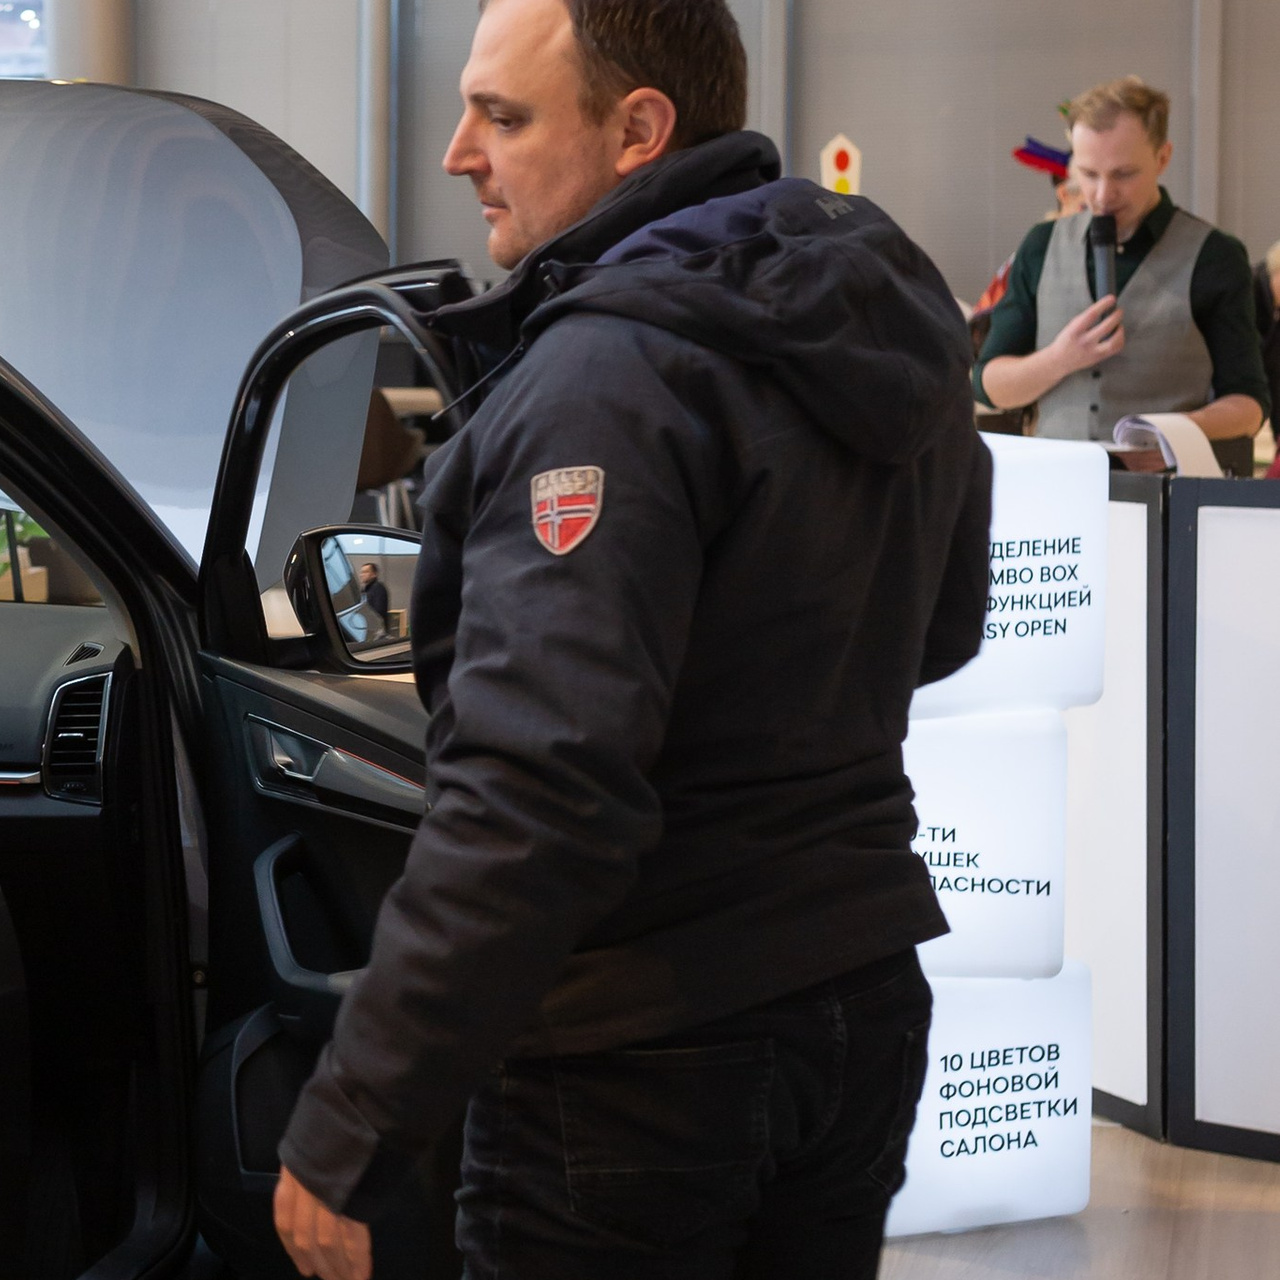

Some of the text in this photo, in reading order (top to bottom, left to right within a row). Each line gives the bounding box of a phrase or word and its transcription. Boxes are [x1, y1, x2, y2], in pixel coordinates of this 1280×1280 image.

[989, 537, 1081, 561] ДЕЛЕНИЕ
[989, 564, 1079, 587] MBO BOX
[982, 618, 1068, 640] SY OPEN
[939, 1043, 1061, 1073] 10 ЦВЕТОВ
[939, 1065, 1059, 1101] ФОНОВОЙ
[939, 1096, 1078, 1130] ПОДСВЕТКИ
[940, 1129, 1039, 1158] САЛОНА
